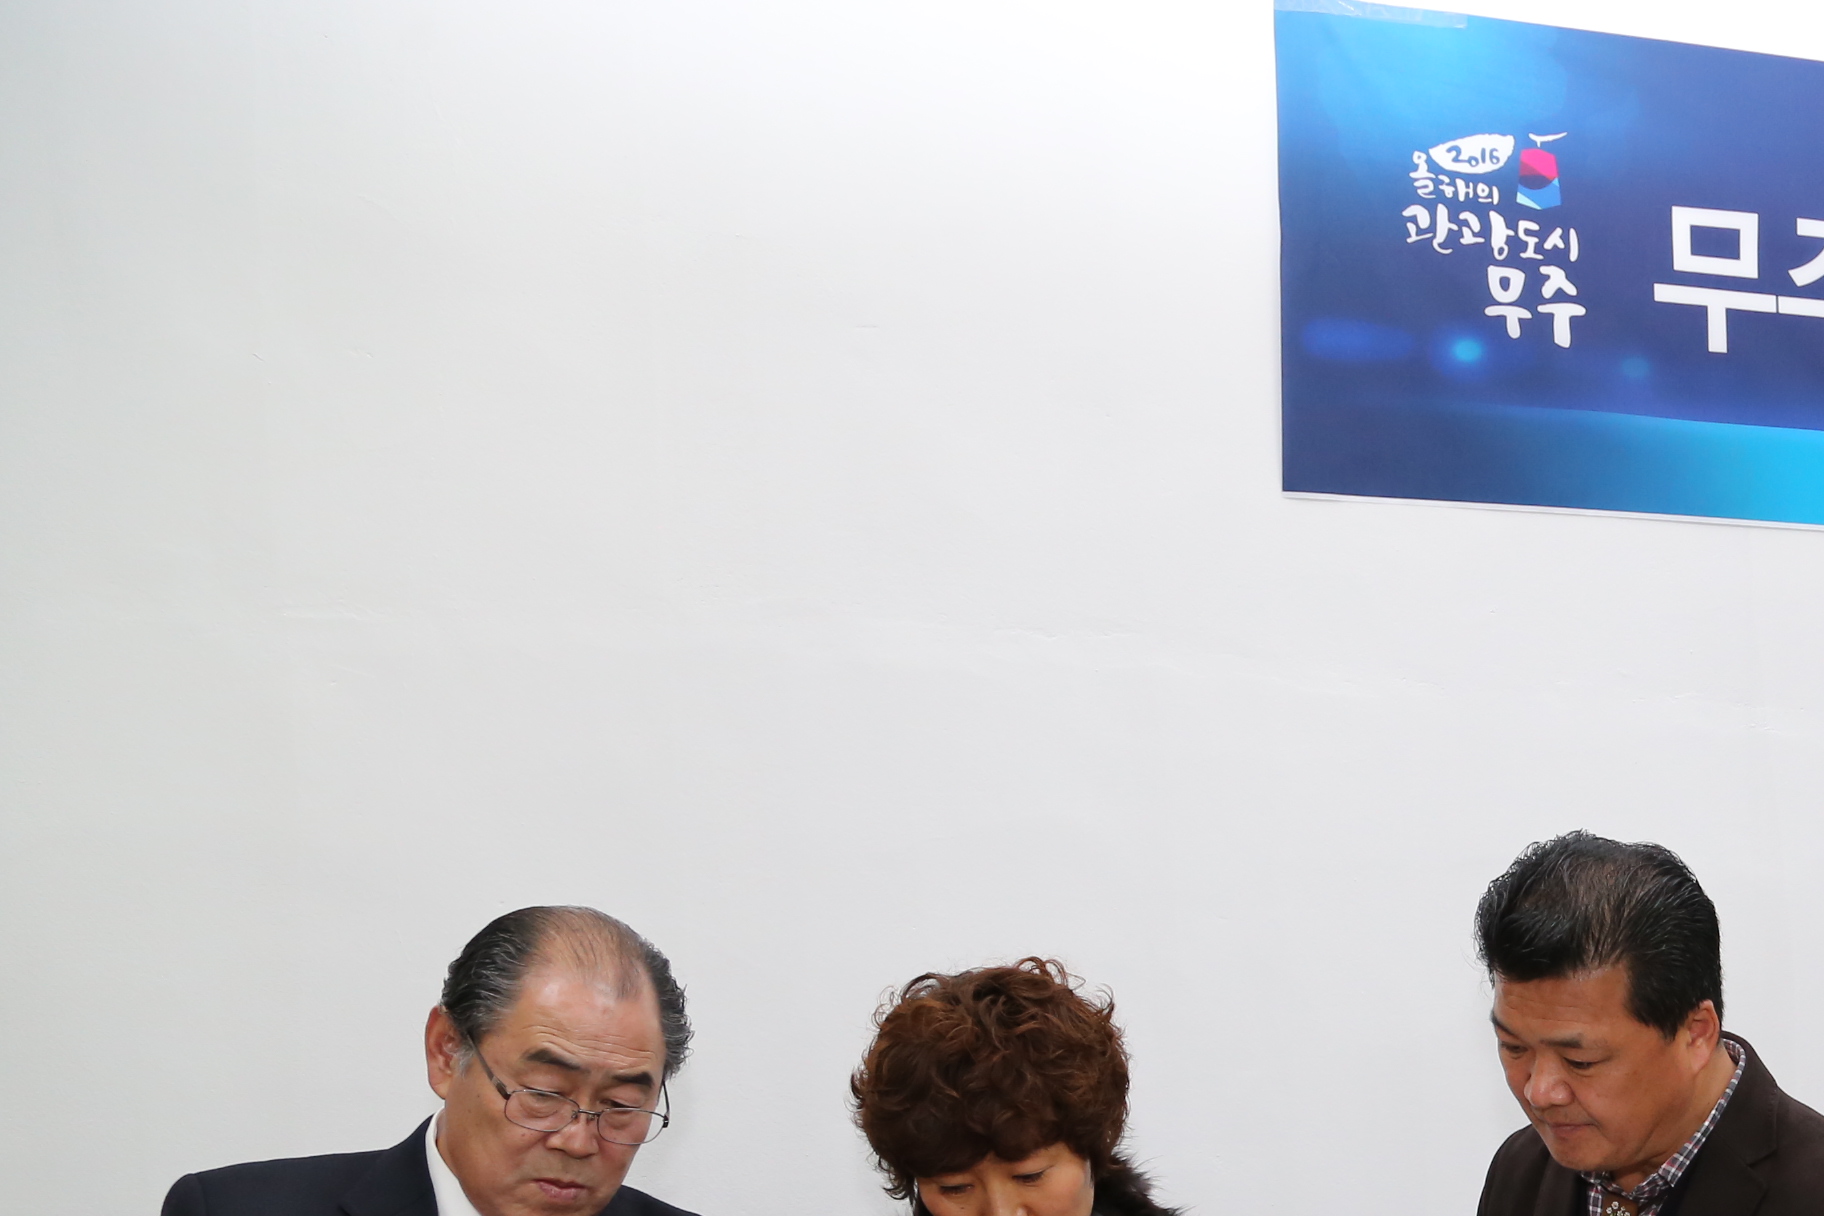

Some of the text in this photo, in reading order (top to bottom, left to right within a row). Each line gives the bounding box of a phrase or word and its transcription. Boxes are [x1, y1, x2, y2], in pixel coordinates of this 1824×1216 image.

[1409, 150, 1499, 205] 올해의
[1446, 145, 1500, 168] 2016
[1402, 203, 1579, 262] 관광도시
[1484, 265, 1587, 348] 무주
